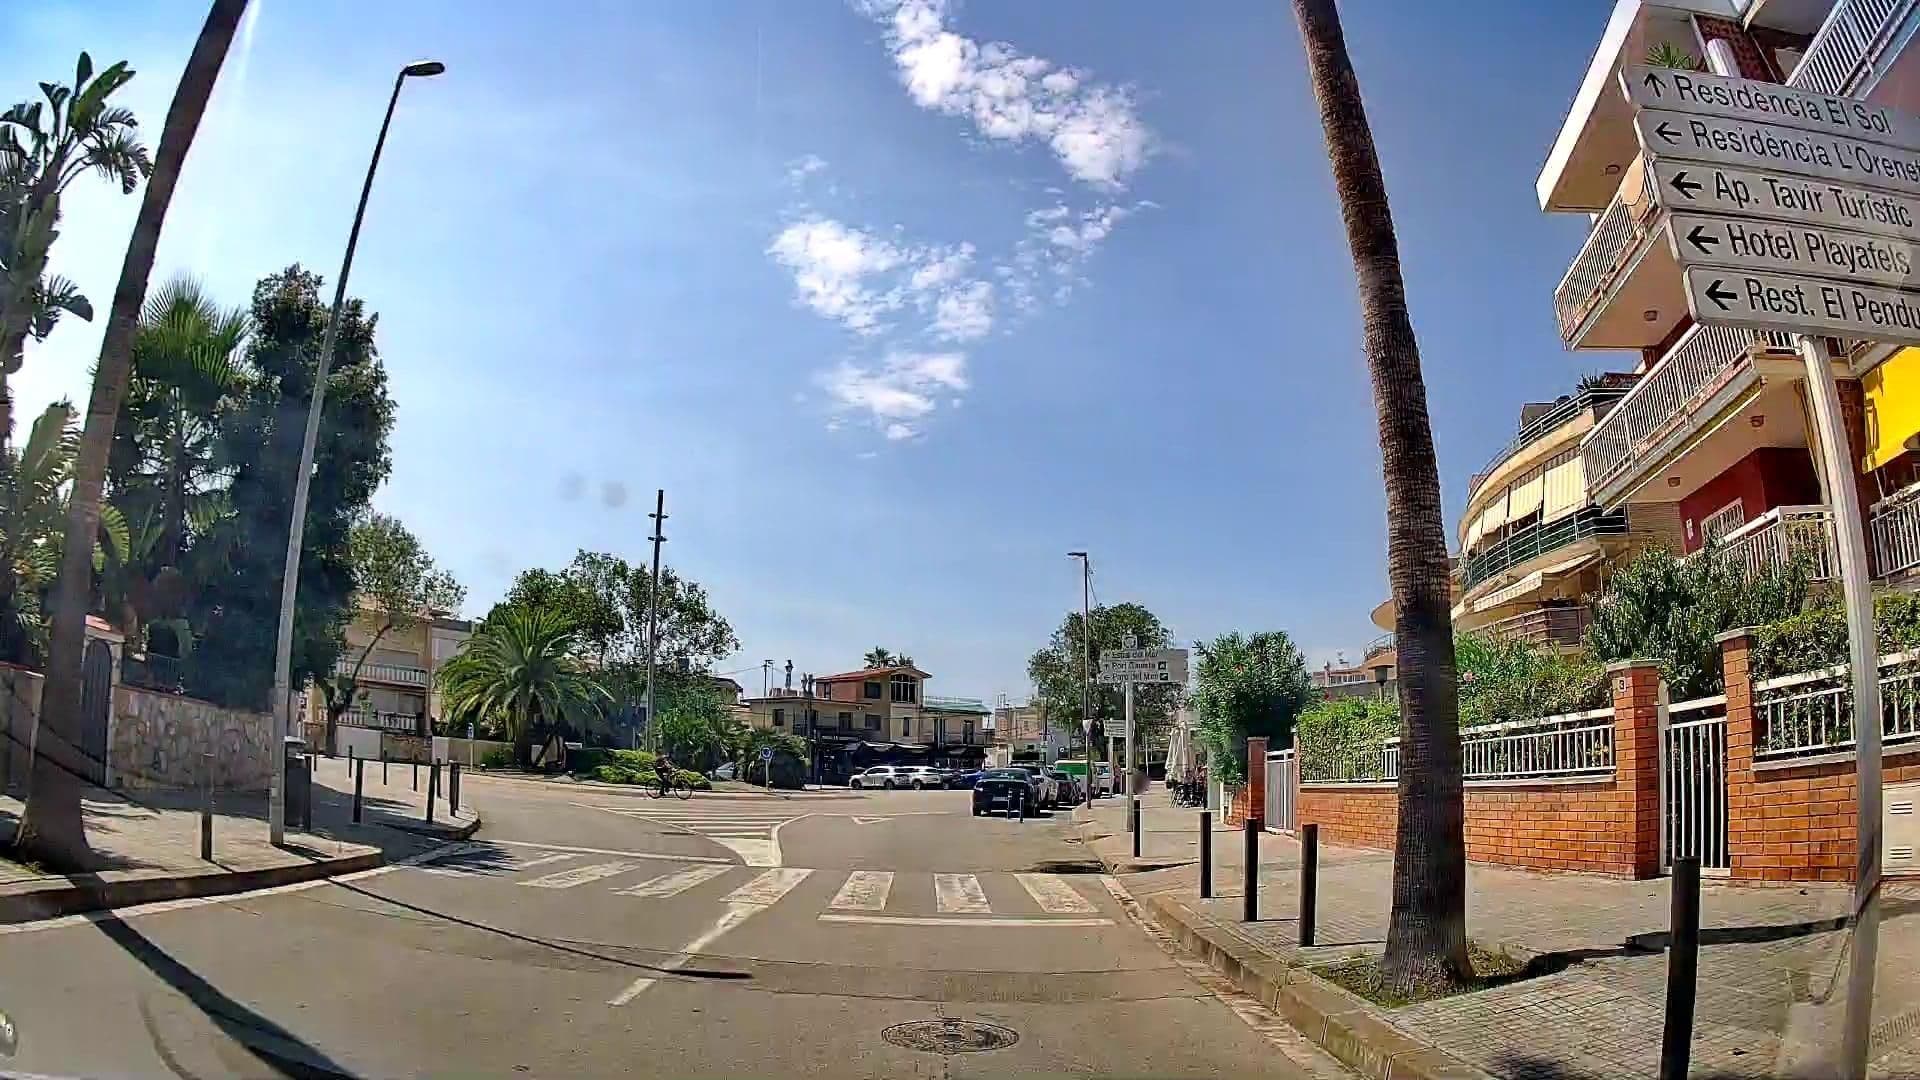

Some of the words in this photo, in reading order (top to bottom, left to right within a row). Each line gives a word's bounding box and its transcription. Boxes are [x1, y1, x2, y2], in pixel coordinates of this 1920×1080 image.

[1674, 75, 1824, 122] Residència
[1825, 98, 1851, 127] El
[1853, 103, 1893, 135] Sol
[1689, 120, 1833, 167] Residència
[1714, 171, 1760, 208] Ap.
[1762, 178, 1824, 213] Tavir
[1727, 223, 1800, 260] Hotel
[1804, 232, 1912, 275] Playafels
[1744, 278, 1816, 317] Rest.
[1820, 287, 1848, 320] El
